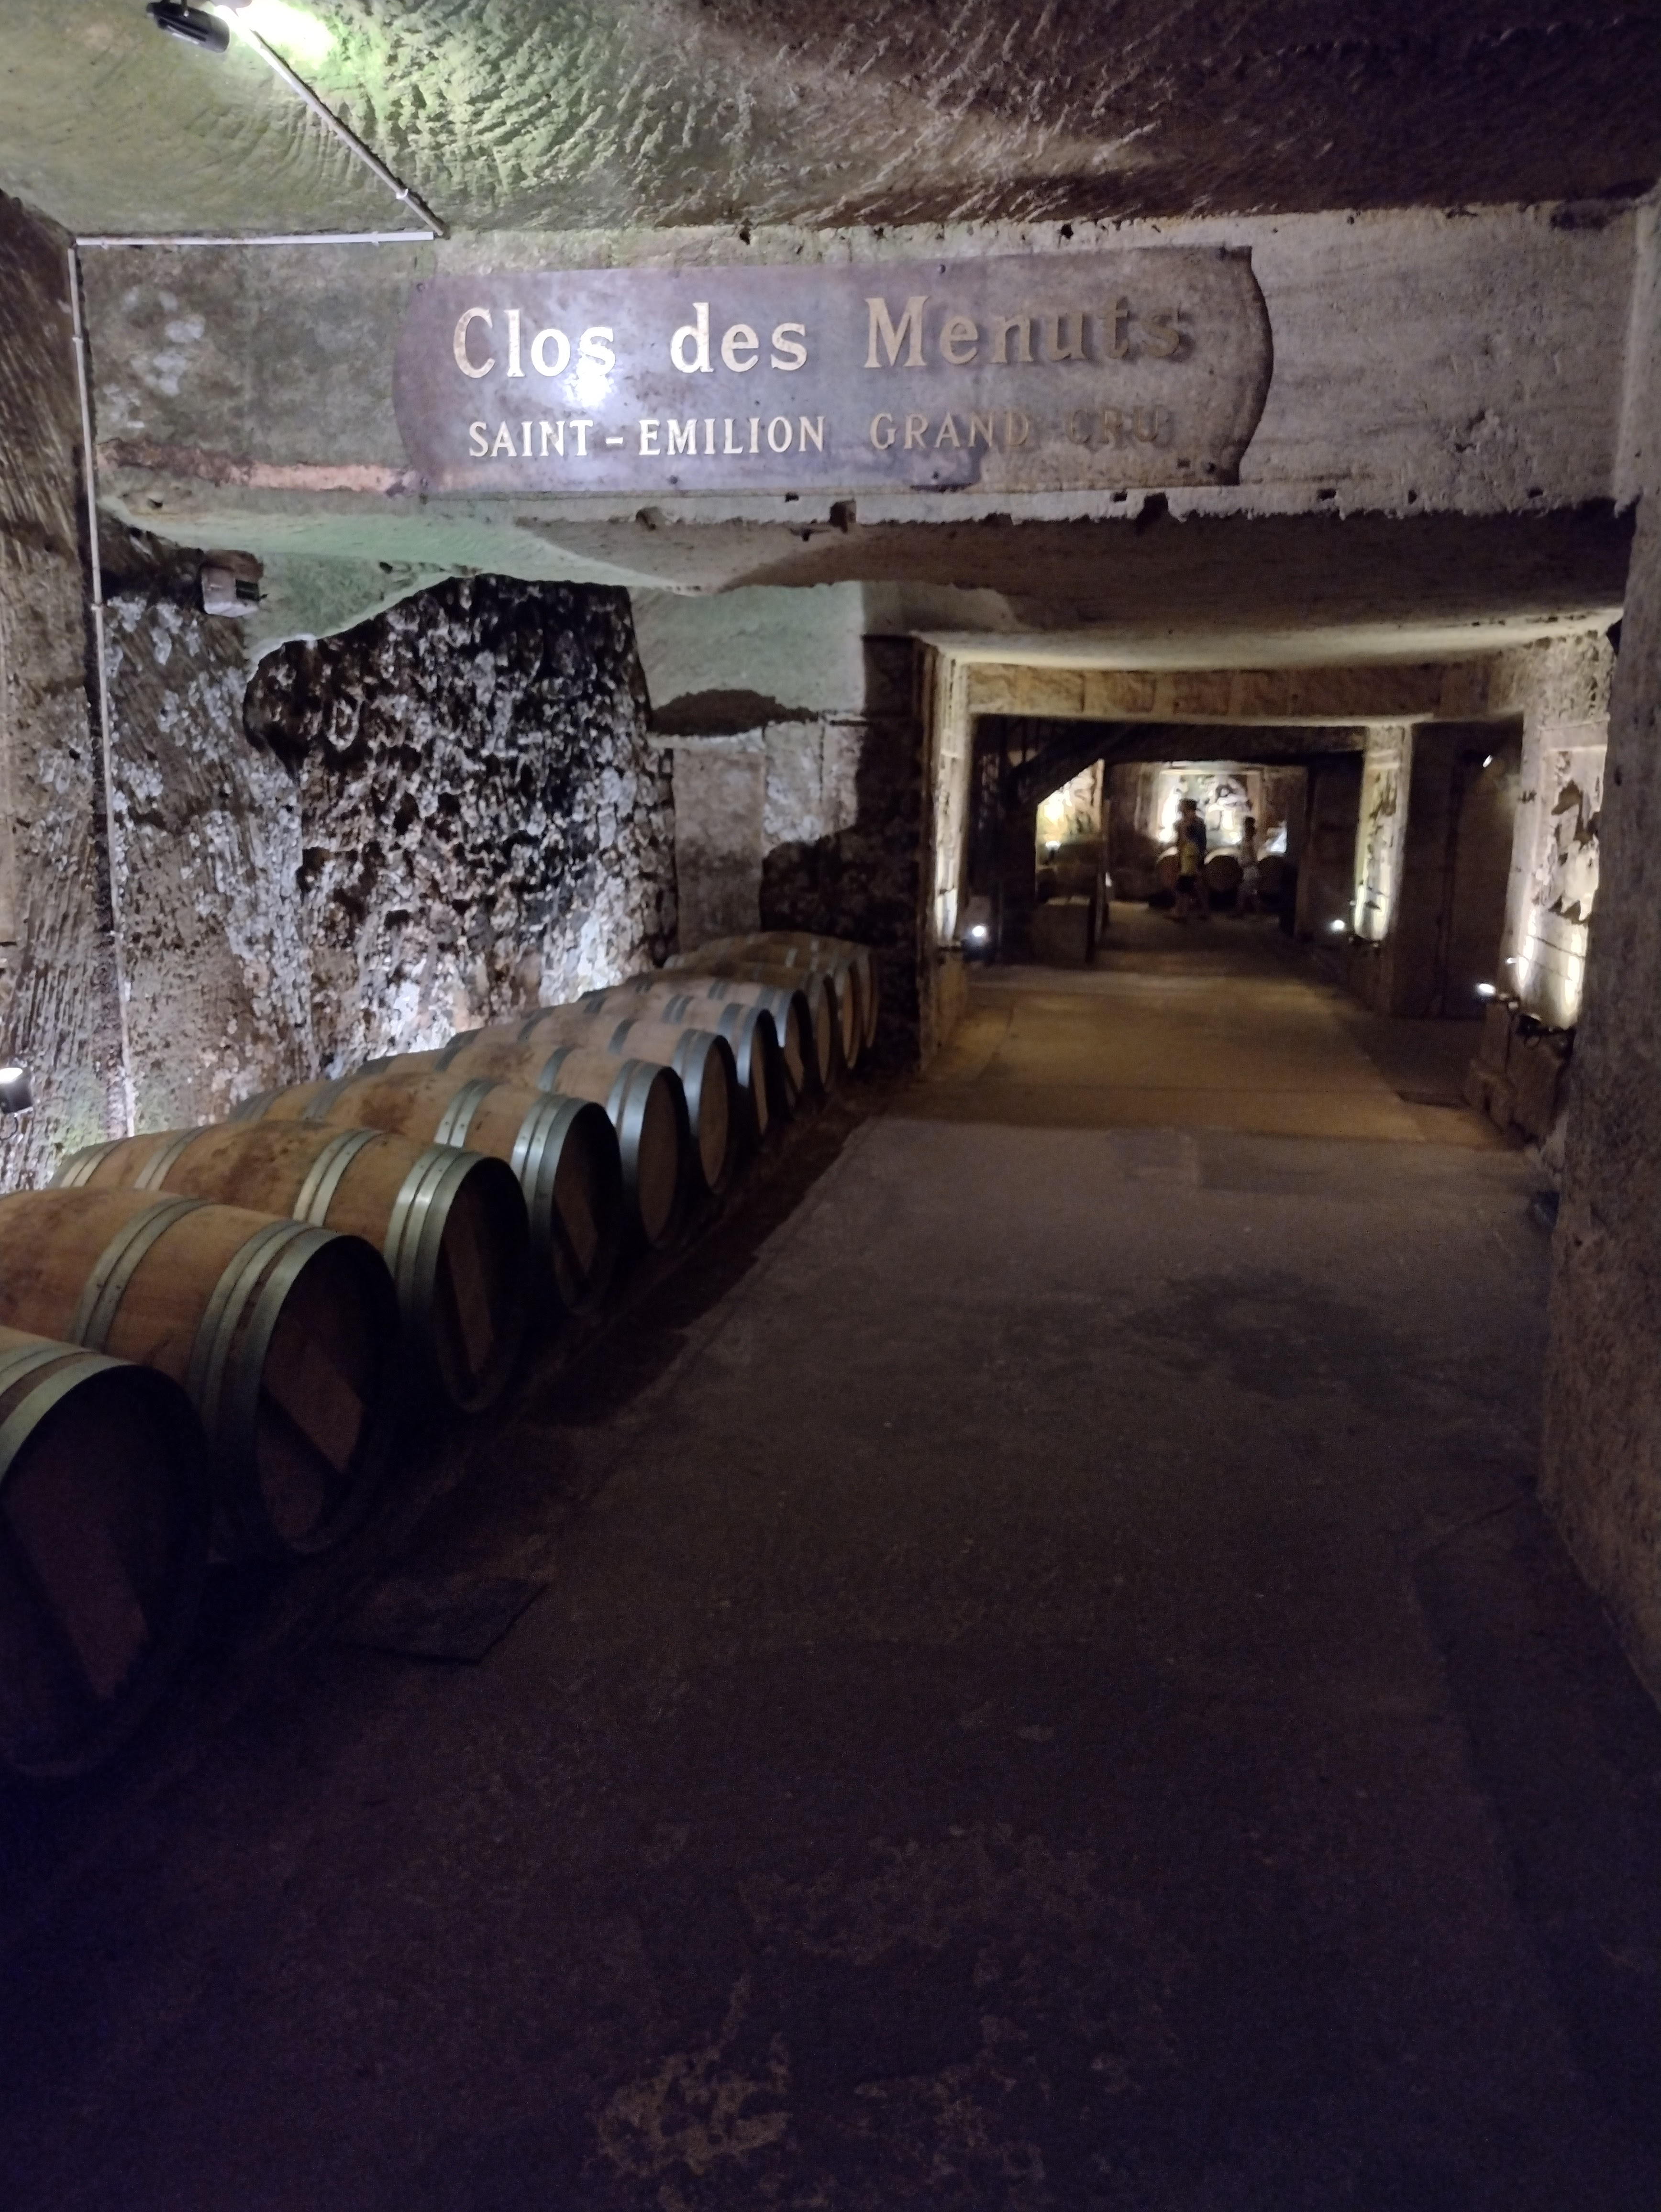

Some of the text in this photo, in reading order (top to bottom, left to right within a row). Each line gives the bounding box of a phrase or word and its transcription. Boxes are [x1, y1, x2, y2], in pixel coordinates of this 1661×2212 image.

[453, 295, 1182, 378] Clos des Menuts
[869, 409, 1030, 451] GRAND
[1065, 404, 1162, 445] CRU
